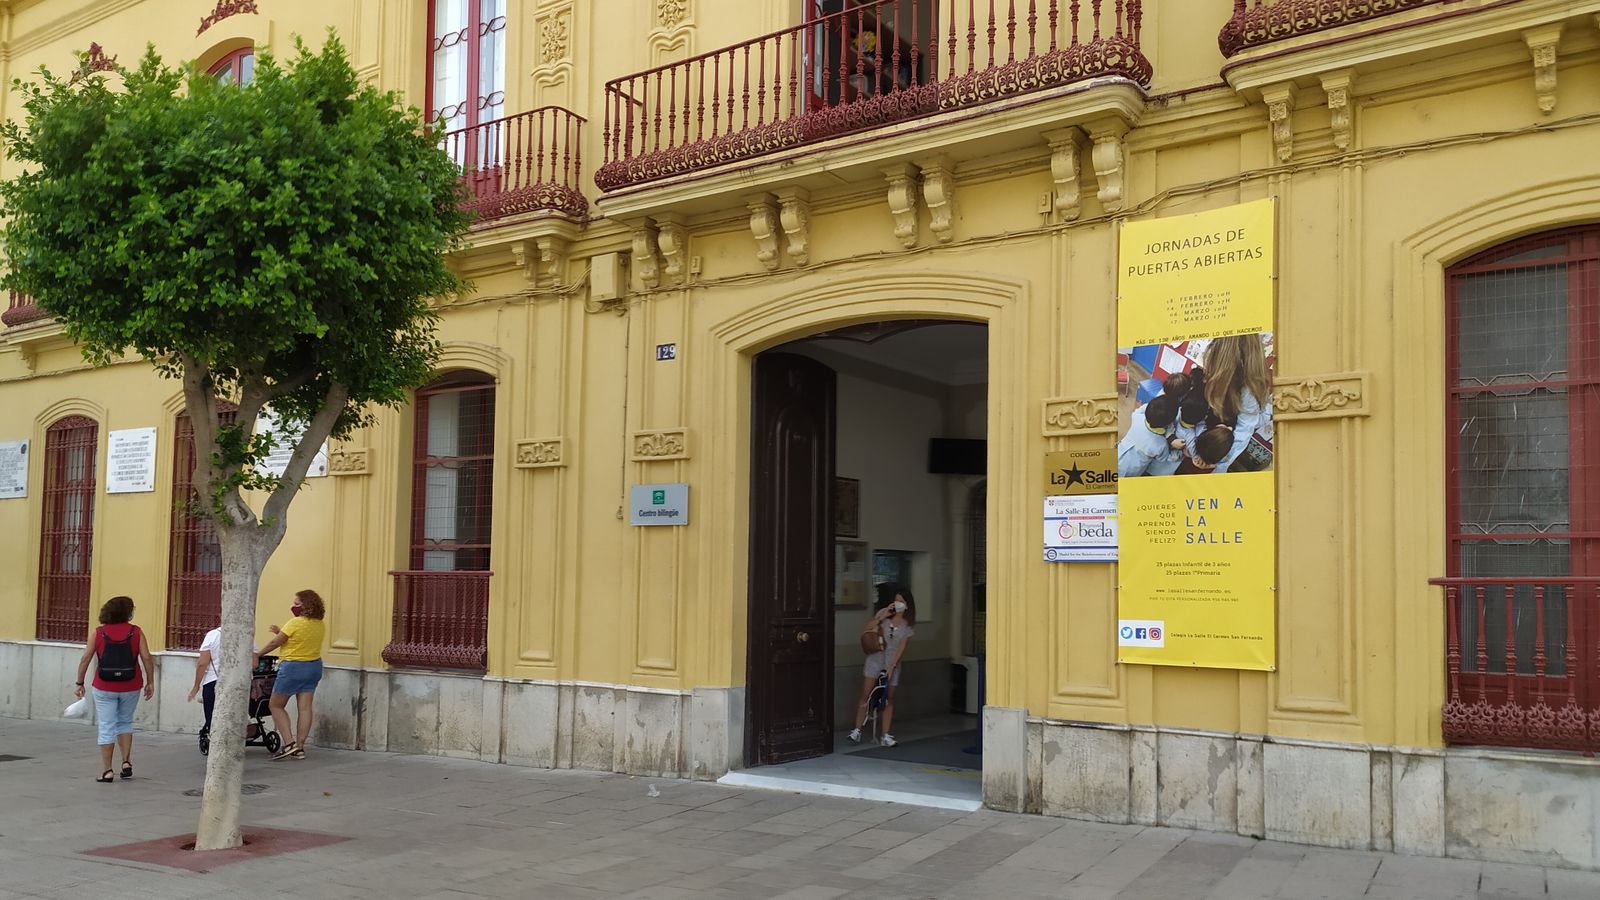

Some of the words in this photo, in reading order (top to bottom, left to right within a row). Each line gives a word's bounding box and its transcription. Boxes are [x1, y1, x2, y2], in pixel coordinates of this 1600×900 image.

[1144, 232, 1222, 255] JORNADAS
[1226, 228, 1246, 242] DE
[1128, 258, 1189, 278] PUERTAS
[1193, 246, 1264, 269] ABIERTAS
[1179, 293, 1214, 302] FEBRERO
[1180, 300, 1214, 309] FEBRERO
[1184, 307, 1210, 315] MARZO
[1183, 314, 1210, 322] MARZO
[1135, 337, 1146, 345] MÁS
[1172, 334, 1186, 342] AÑOS
[1237, 326, 1263, 334] HACEMOS
[657, 344, 676, 359] 129
[1051, 472, 1066, 485] La
[1085, 469, 1118, 484] Salle
[1136, 503, 1177, 512] ¿QUIERES
[1185, 498, 1219, 511] VEN
[1234, 497, 1244, 509] A
[638, 509, 657, 517] Centro
[657, 508, 680, 518] bilingüe
[1186, 515, 1207, 528] LA
[1186, 531, 1243, 544] SALLE
